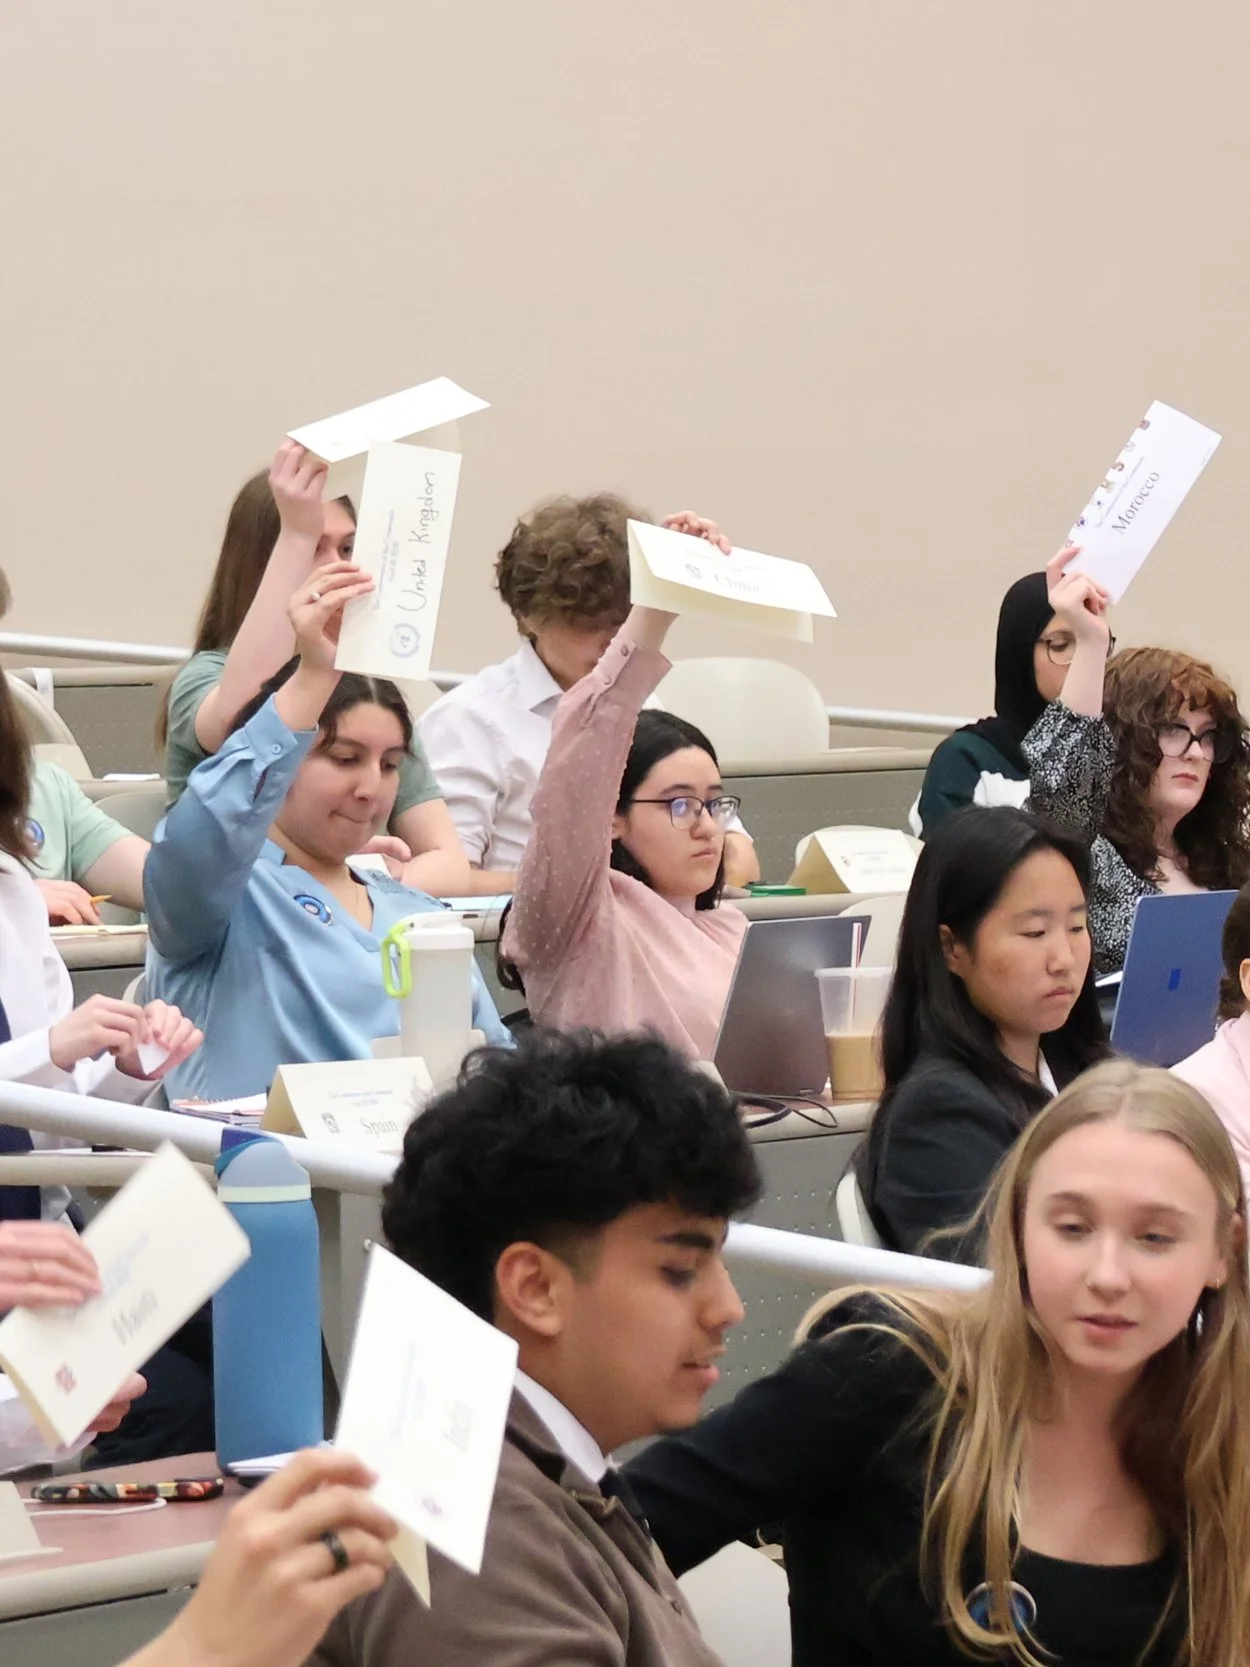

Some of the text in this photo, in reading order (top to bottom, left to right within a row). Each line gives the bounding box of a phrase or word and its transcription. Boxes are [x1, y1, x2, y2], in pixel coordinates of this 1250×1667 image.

[1111, 472, 1160, 535] Morocco
[396, 559, 427, 611] United
[359, 1115, 400, 1138] Spain
